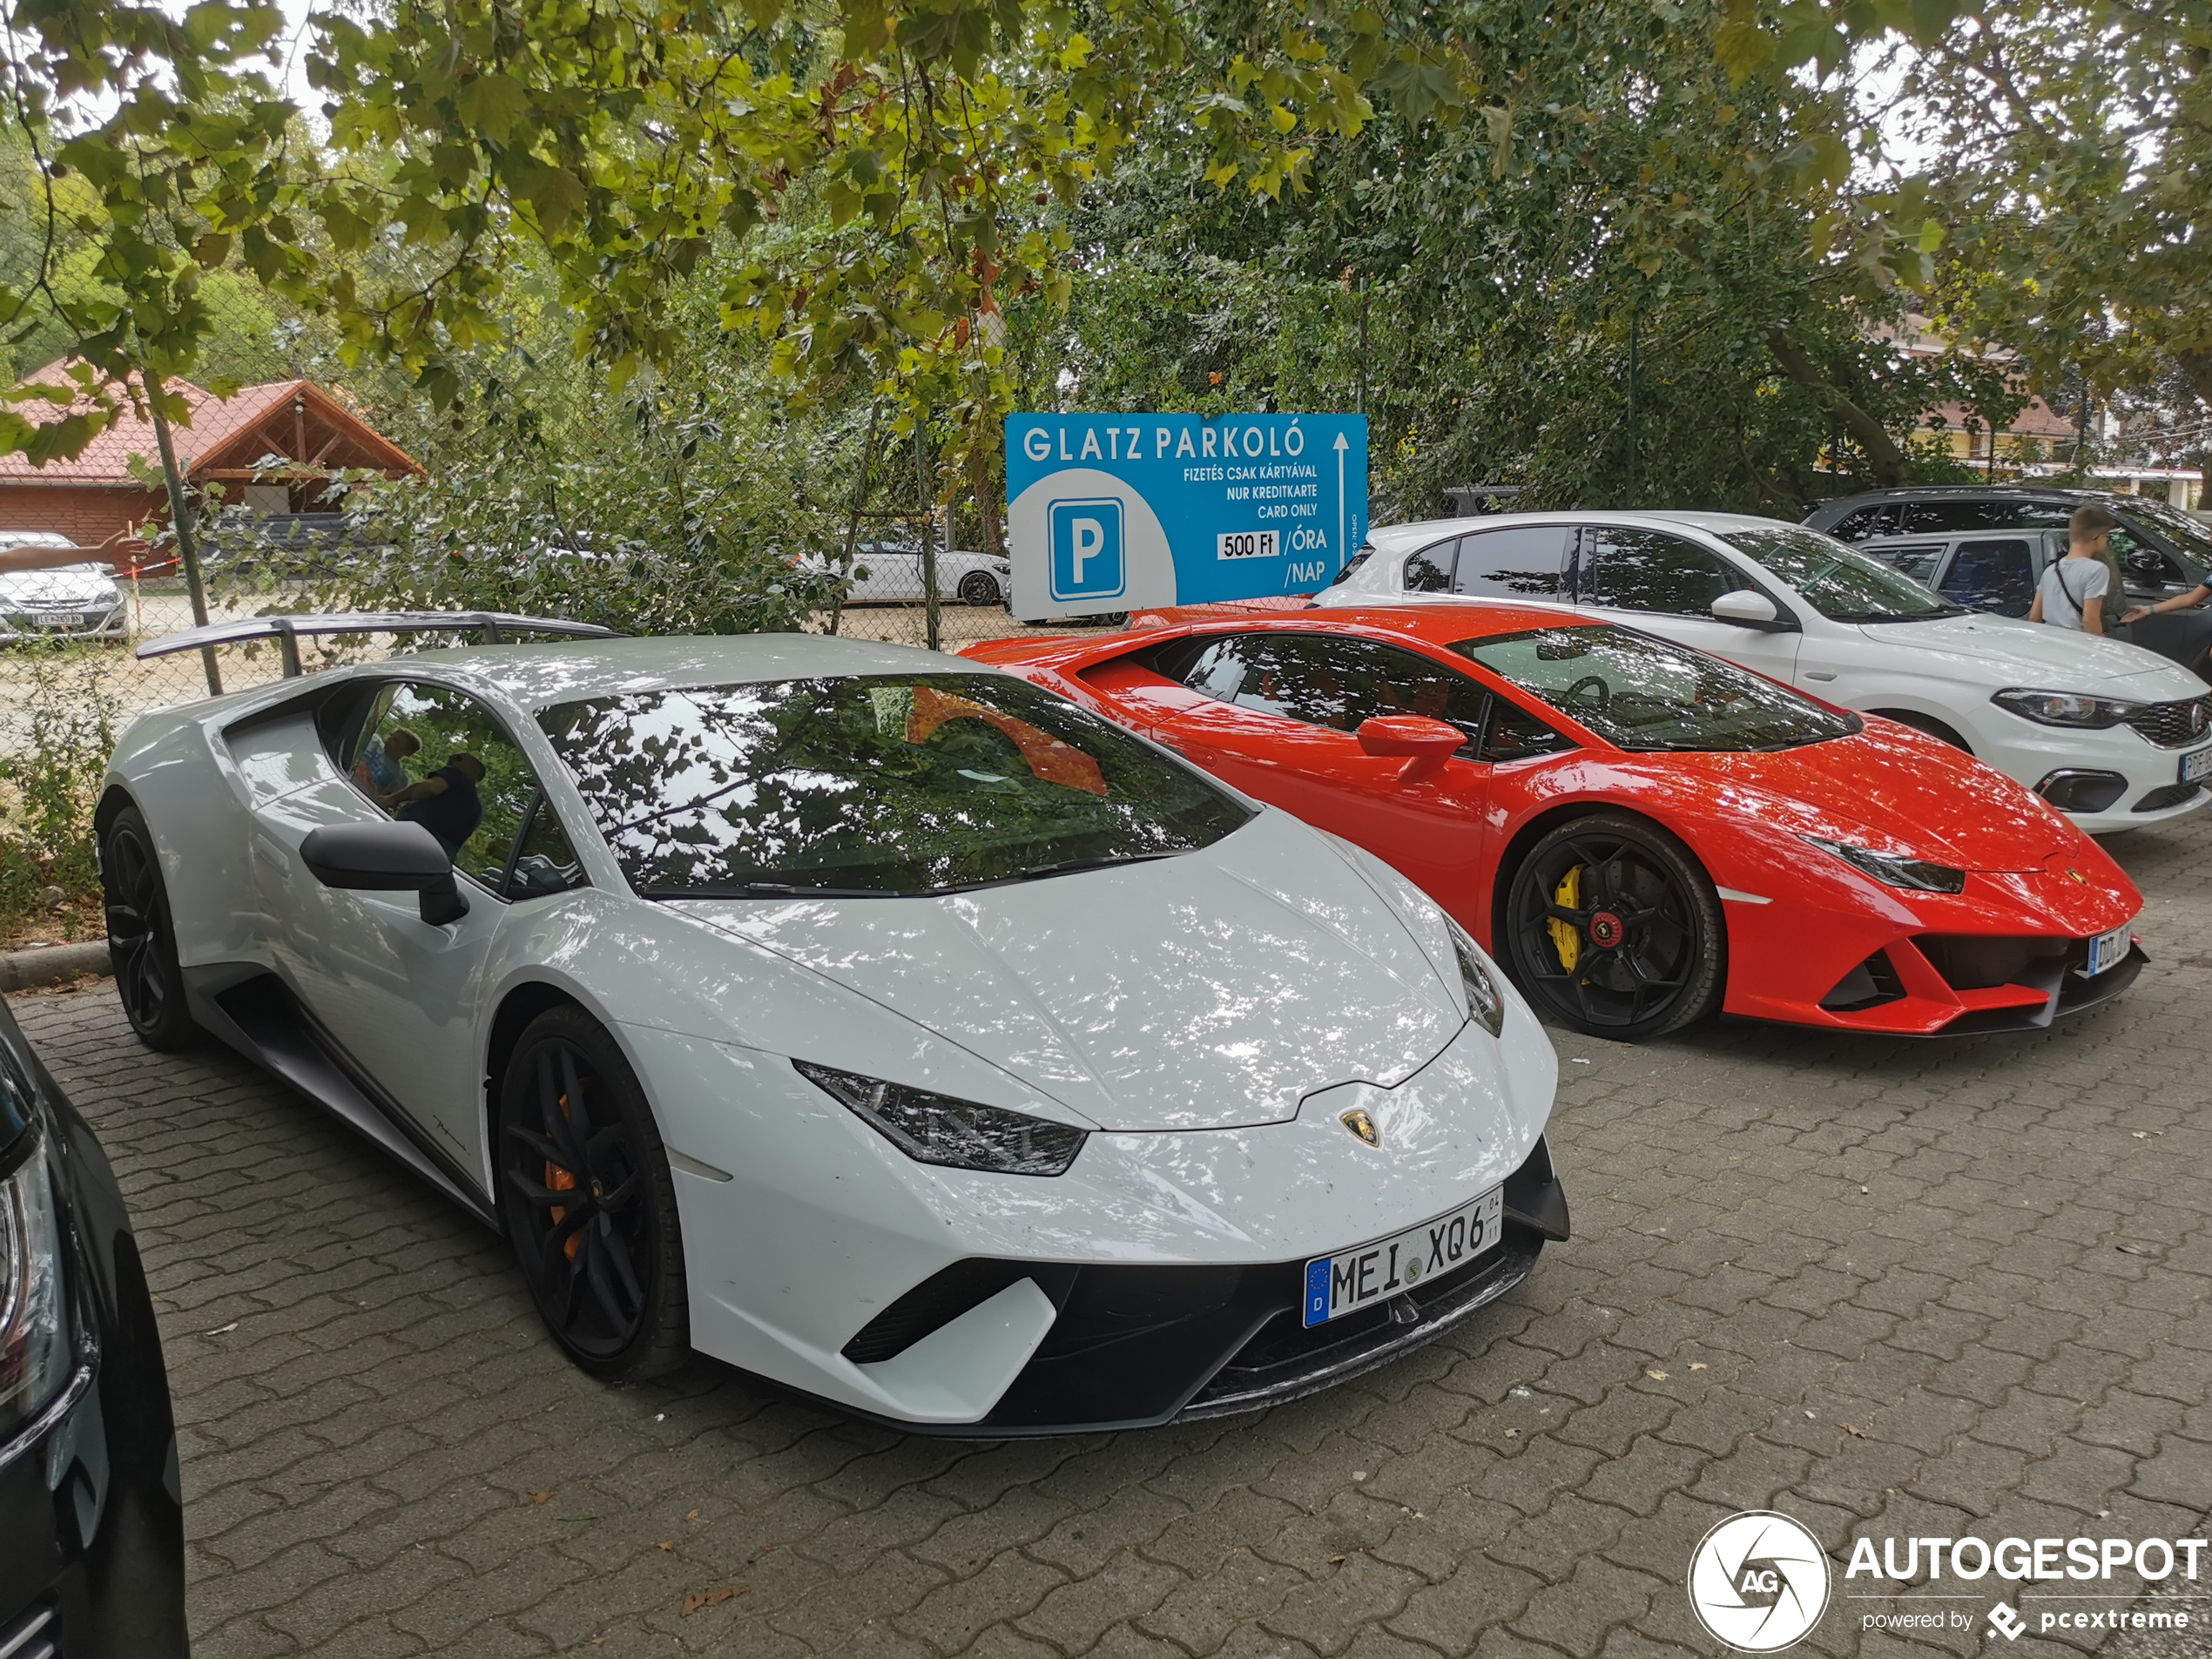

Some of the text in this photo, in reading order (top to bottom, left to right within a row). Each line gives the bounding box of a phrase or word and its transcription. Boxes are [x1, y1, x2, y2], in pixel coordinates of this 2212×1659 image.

[1023, 417, 1305, 462] GLATZ PARKOLÓ
[1184, 462, 1318, 482] FIZETÉS CSAK KÁRTYÁVAL
[1227, 484, 1318, 501] NUR KREDITKARTE
[1258, 503, 1318, 519] CARD ONLY
[1072, 518, 1104, 583] P
[1224, 523, 1328, 557] 500 Ft /ÓRA
[1284, 561, 1325, 589] /NAP
[1332, 1205, 1484, 1310] MEI XQ6
[1313, 1297, 1323, 1312] D
